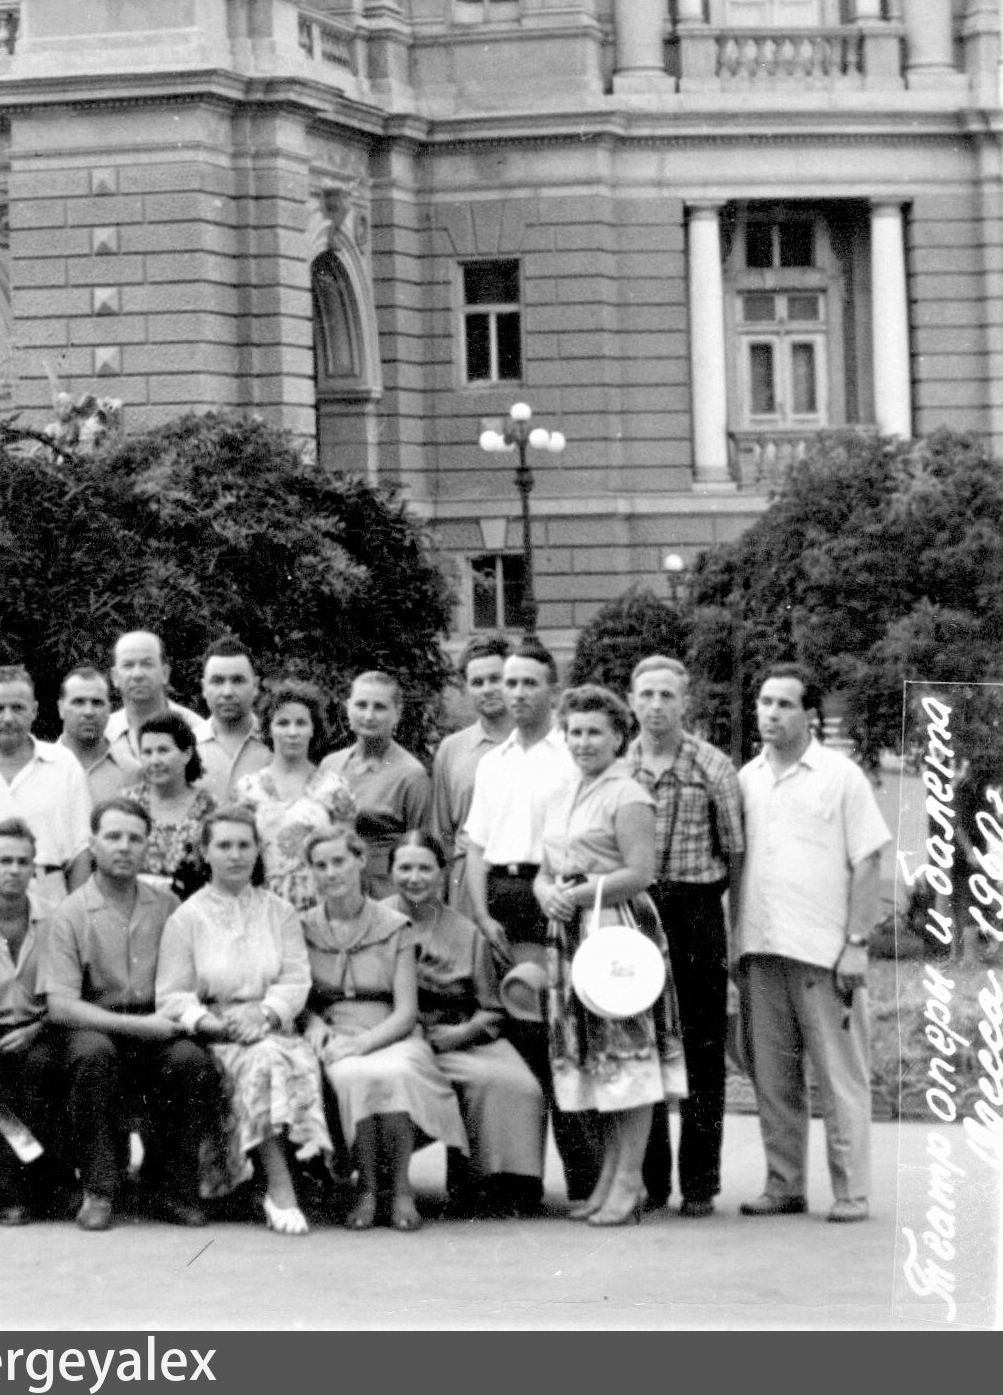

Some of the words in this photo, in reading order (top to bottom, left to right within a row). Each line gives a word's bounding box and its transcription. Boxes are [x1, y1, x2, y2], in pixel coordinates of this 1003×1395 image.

[896, 697, 956, 896] балета
[925, 908, 954, 945] и
[923, 965, 970, 1122] оперы
[901, 1132, 966, 1322] Театр
